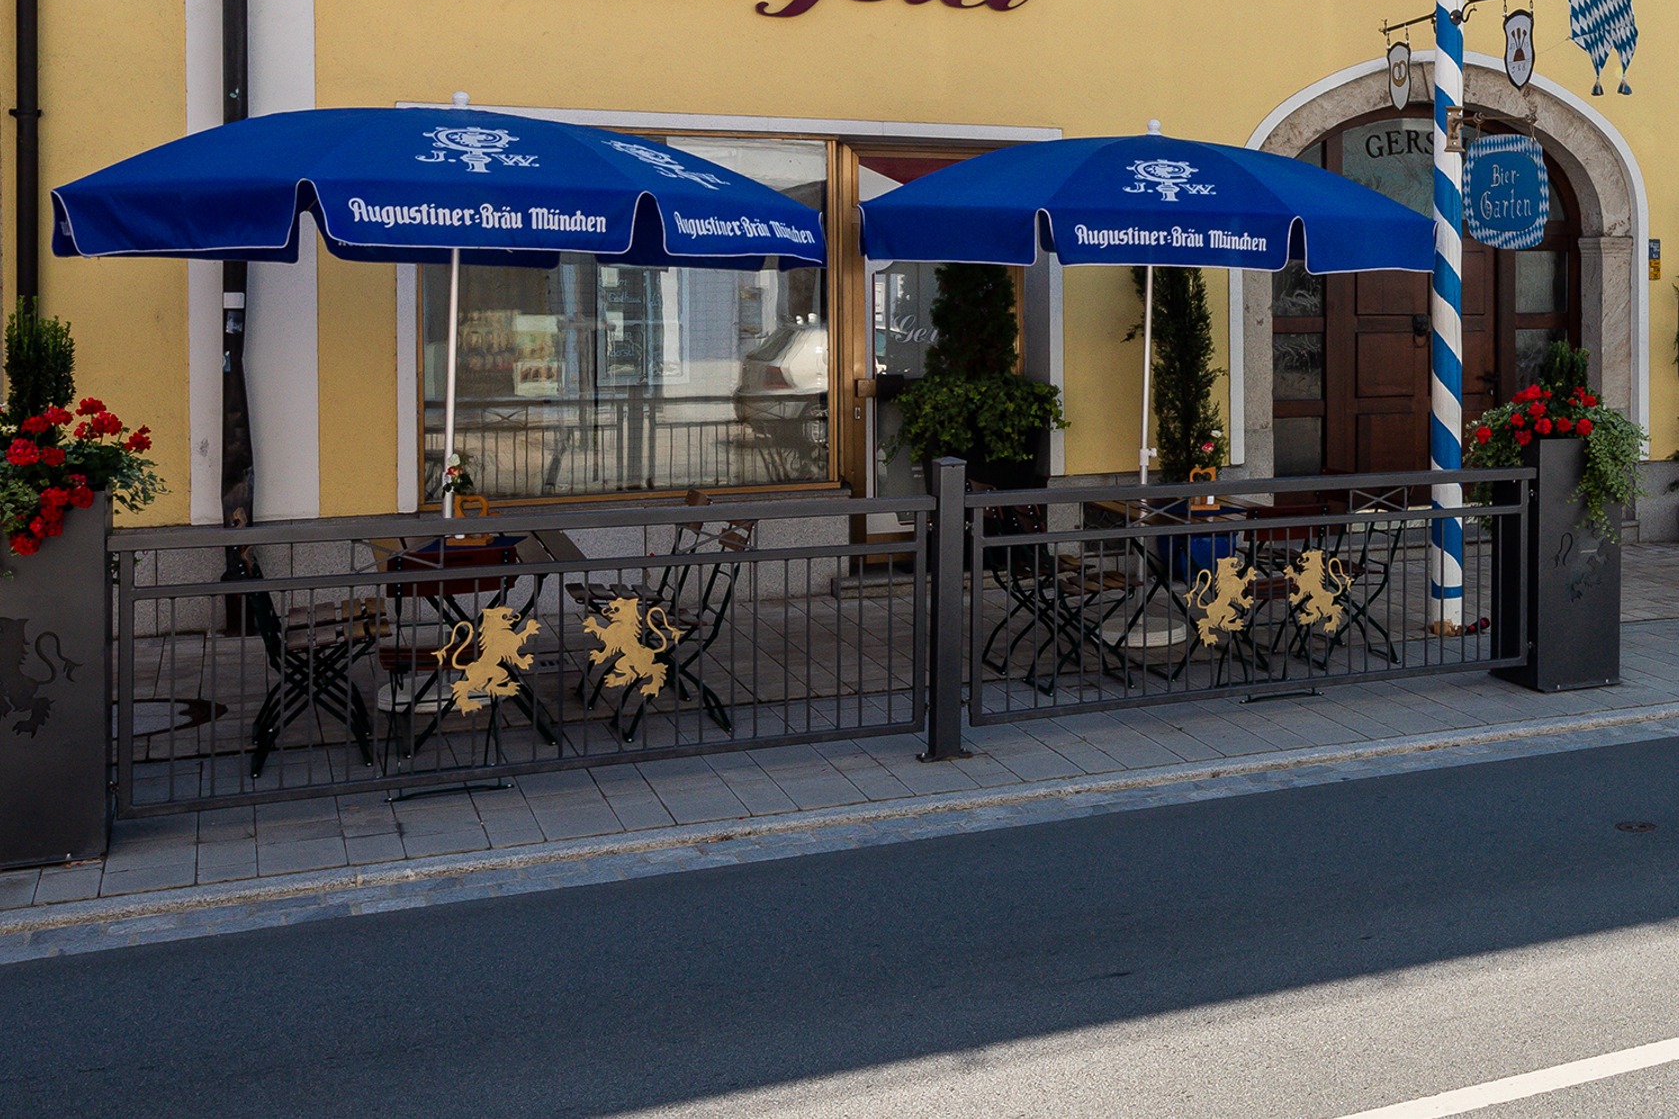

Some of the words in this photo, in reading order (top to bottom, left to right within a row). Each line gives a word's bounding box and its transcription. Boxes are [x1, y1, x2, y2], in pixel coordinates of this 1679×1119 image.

[1491, 164, 1521, 187] Bier-
[1479, 189, 1533, 220] Garten
[528, 207, 607, 233] München
[769, 220, 816, 244] München
[1208, 229, 1268, 252] München
